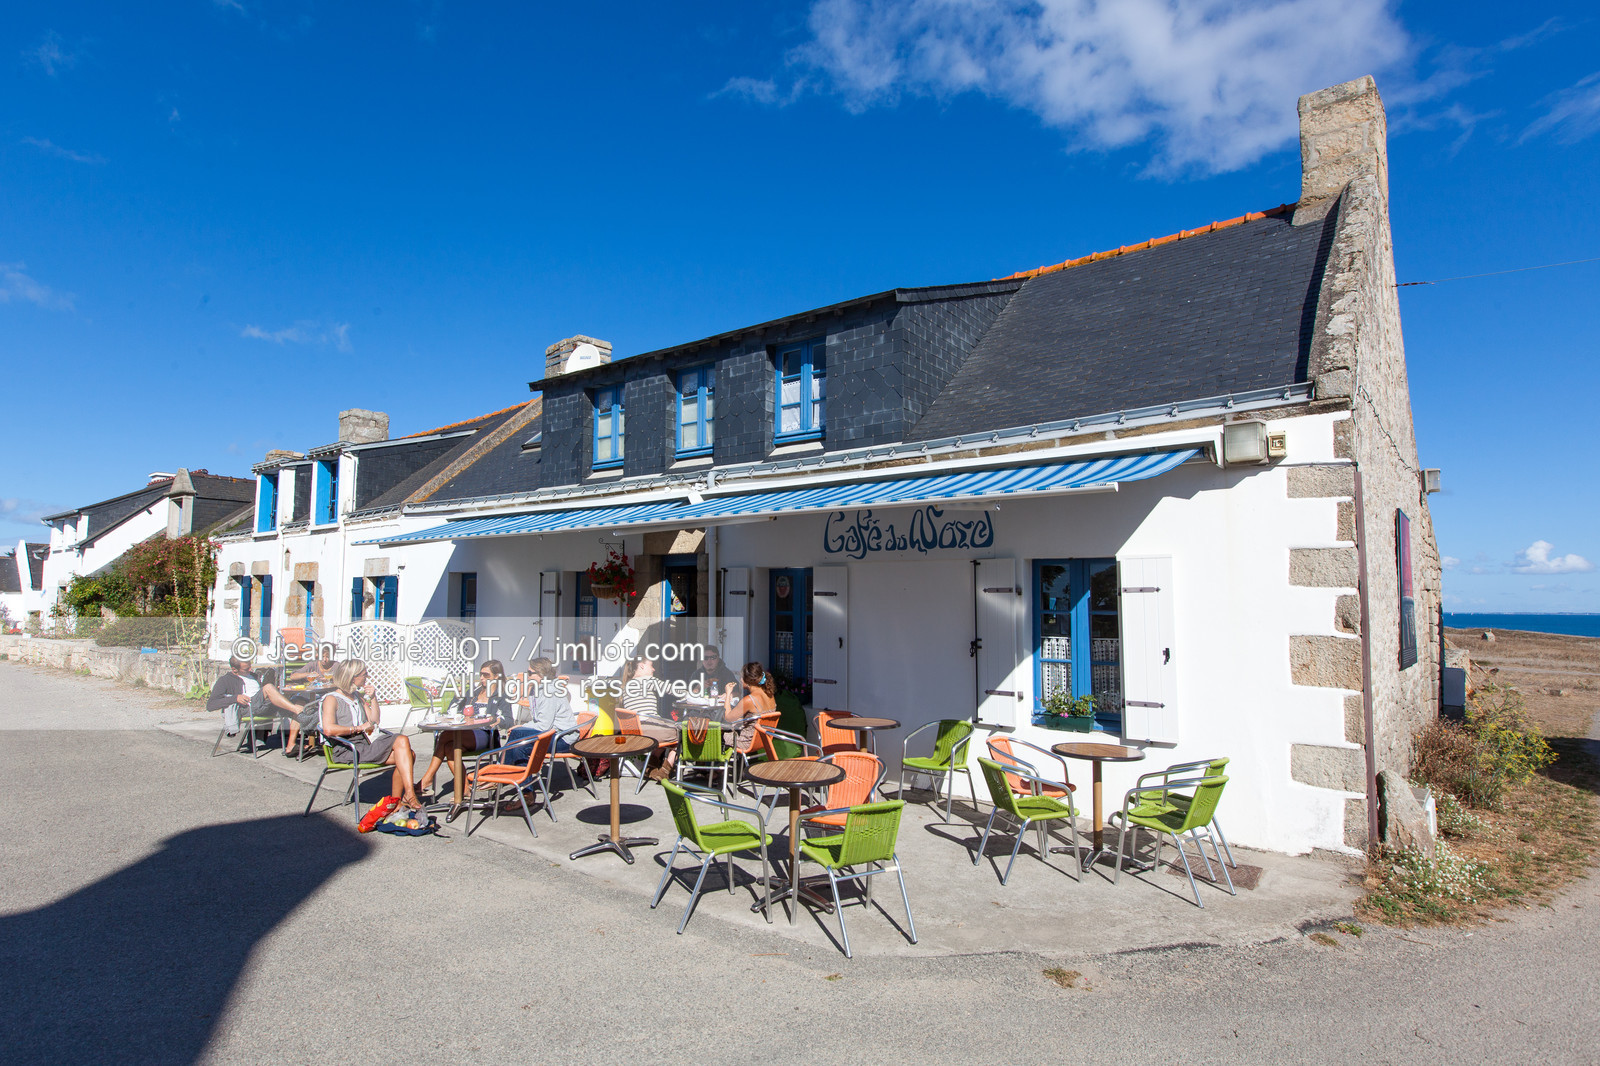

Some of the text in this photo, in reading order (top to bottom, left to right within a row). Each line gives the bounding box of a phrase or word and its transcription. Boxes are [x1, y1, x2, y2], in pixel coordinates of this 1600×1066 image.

[824, 505, 994, 559] Café du Nord
